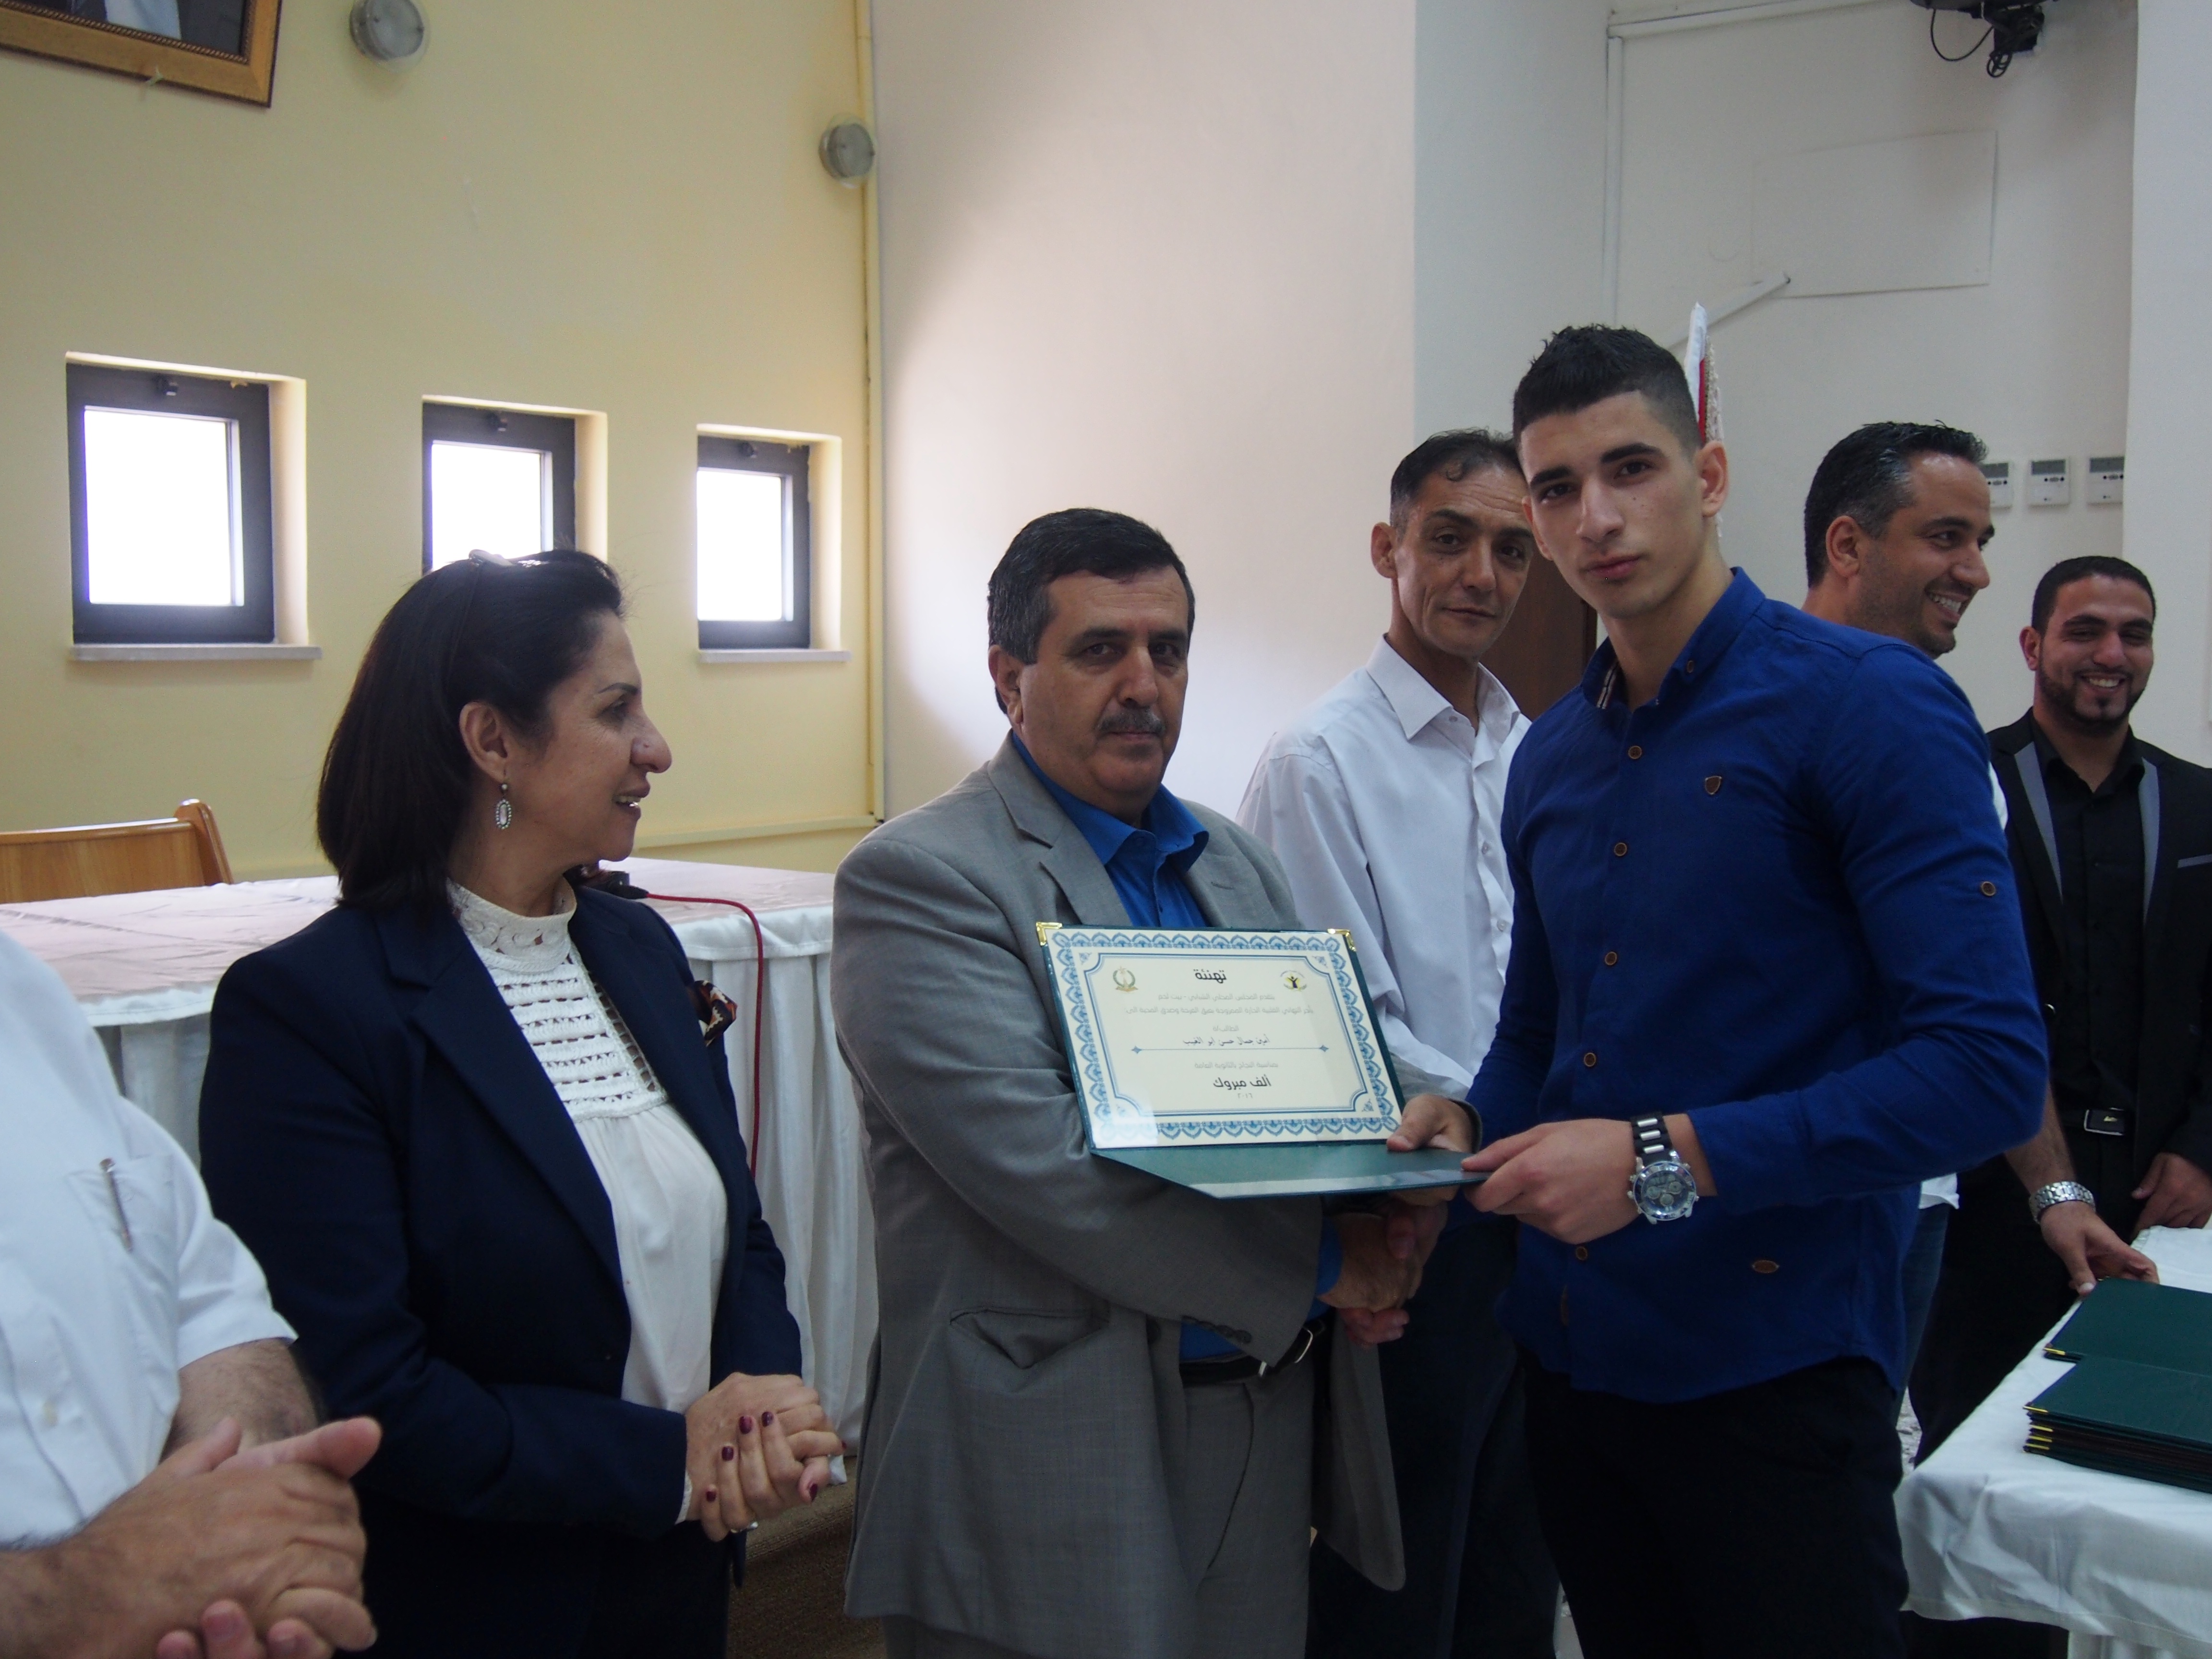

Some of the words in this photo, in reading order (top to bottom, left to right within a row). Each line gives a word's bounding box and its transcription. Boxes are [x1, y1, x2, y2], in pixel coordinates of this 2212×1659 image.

[1193, 968, 1226, 984] تهنئة
[1237, 1036, 1253, 1046] جمال
[1256, 1034, 1270, 1046] أمين
[1213, 1077, 1247, 1090] مبروك
[1250, 1073, 1271, 1087] ألف
